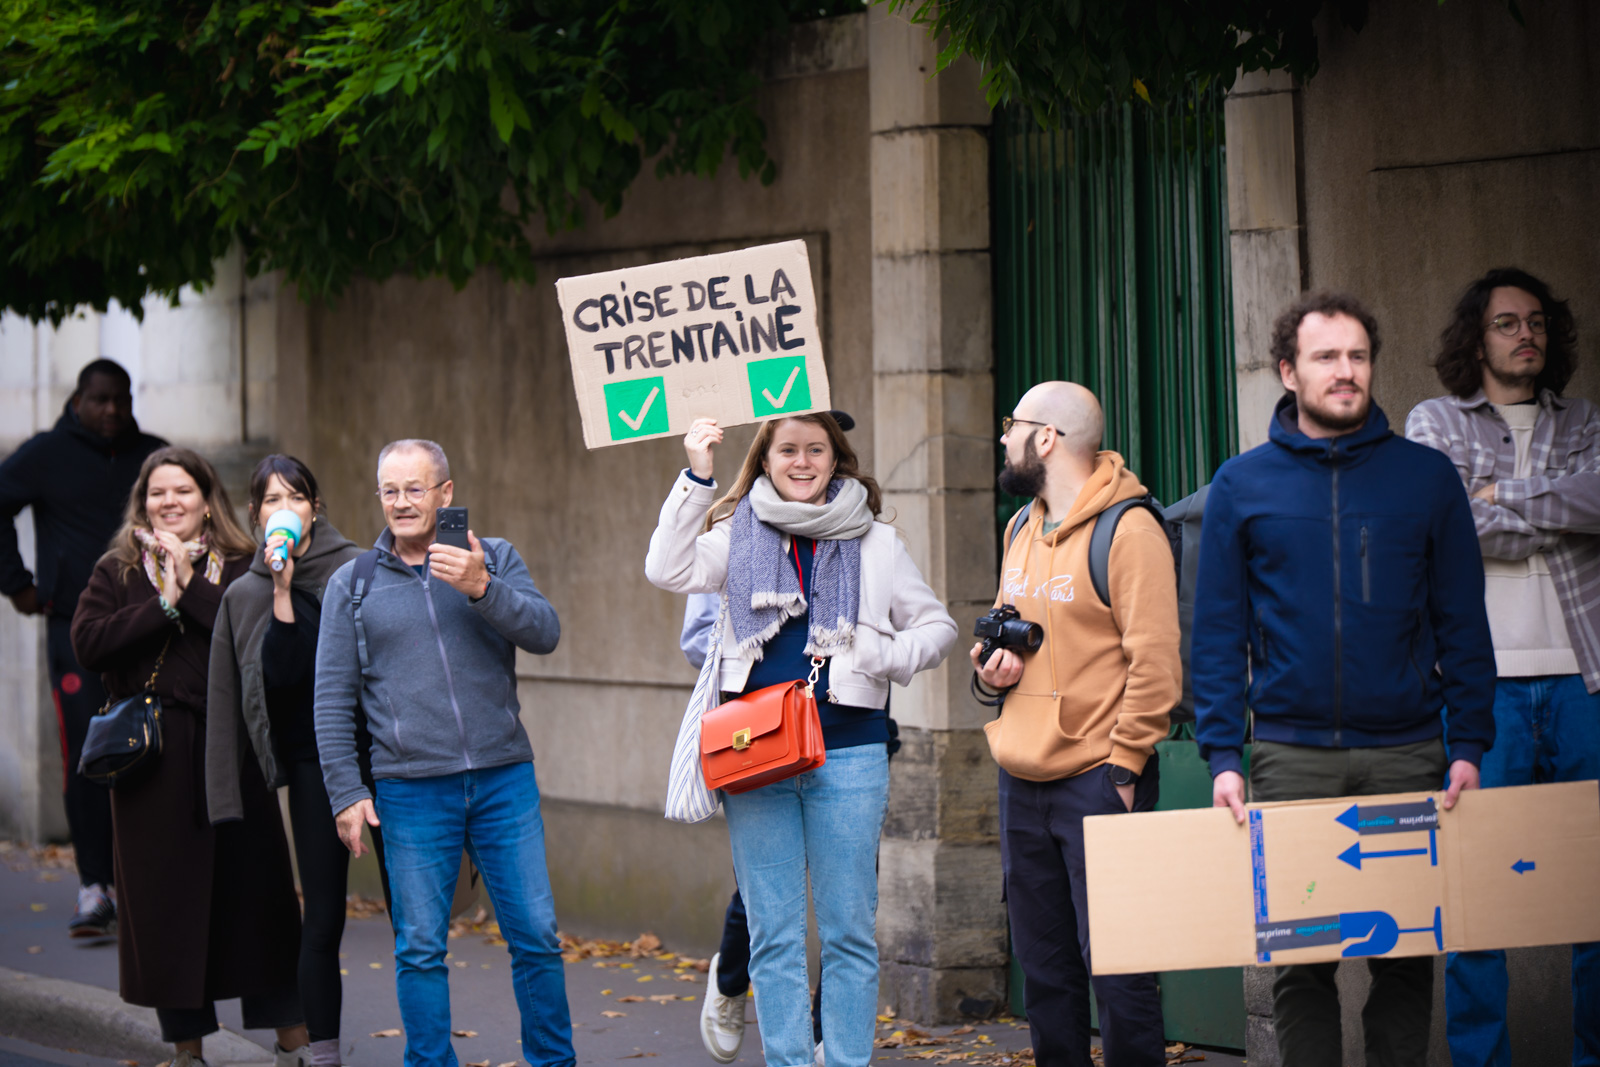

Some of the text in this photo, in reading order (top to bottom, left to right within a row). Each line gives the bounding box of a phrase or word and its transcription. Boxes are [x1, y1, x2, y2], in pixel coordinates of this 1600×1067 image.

[681, 276, 736, 311] DE
[745, 268, 796, 305] LA
[1041, 574, 1074, 607] Paris
[1399, 814, 1424, 826] prime
[1266, 928, 1292, 939] prime
[1295, 924, 1323, 936] amazon
